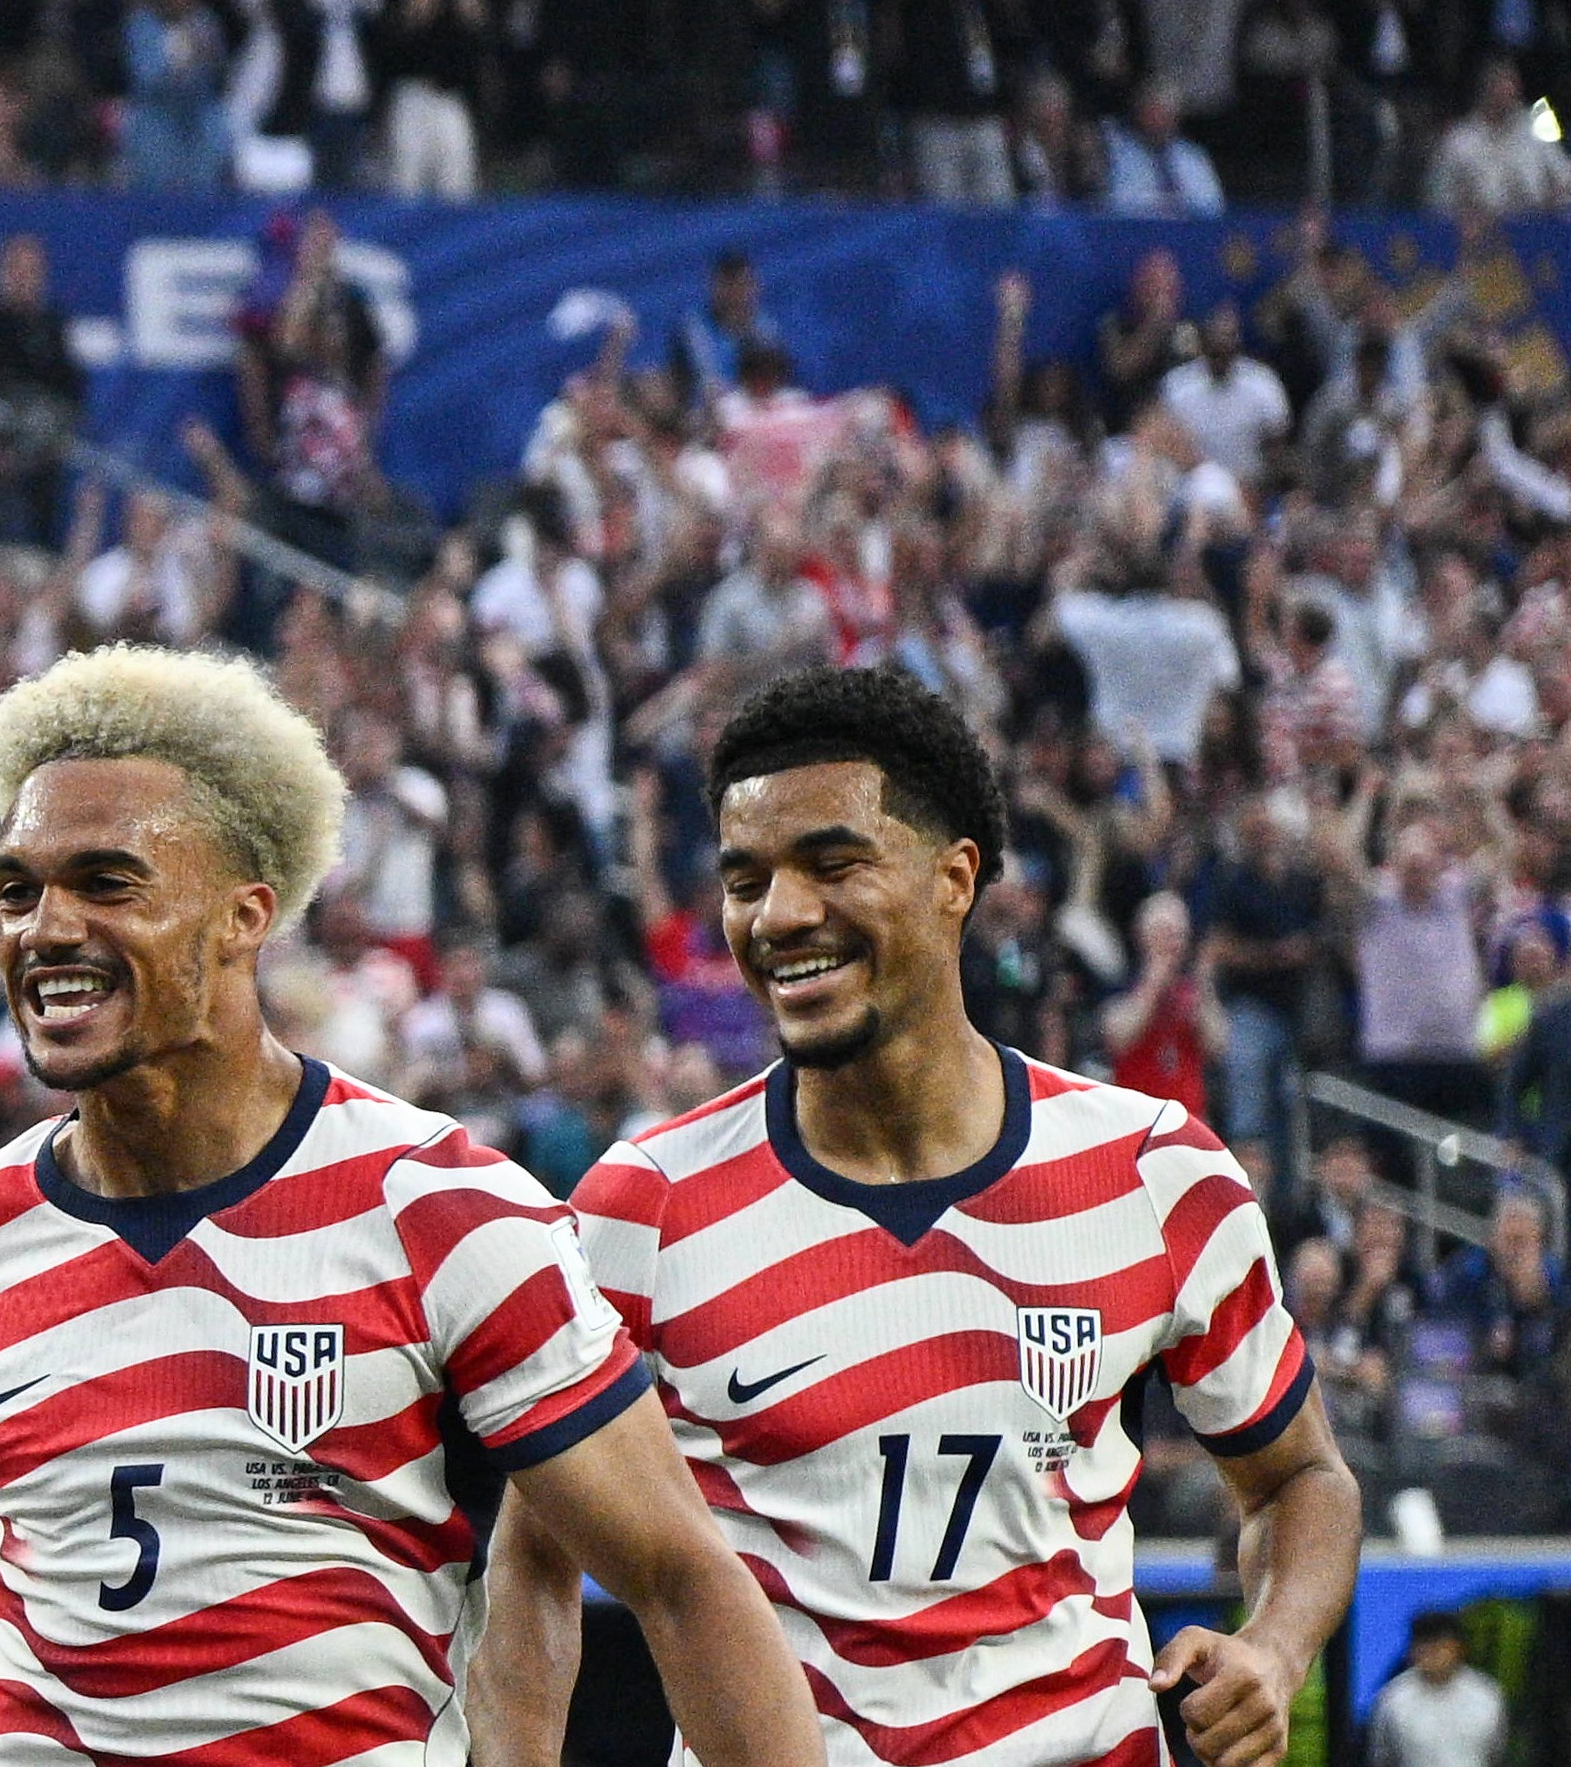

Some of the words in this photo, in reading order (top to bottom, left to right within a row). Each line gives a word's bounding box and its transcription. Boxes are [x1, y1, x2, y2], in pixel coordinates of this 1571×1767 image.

[256, 1331, 337, 1378] USA
[1025, 1314, 1096, 1355] USA
[245, 1462, 266, 1475] USA
[251, 1478, 271, 1490] LOS
[869, 1433, 1003, 1582] 17
[98, 1464, 165, 1612] 5
